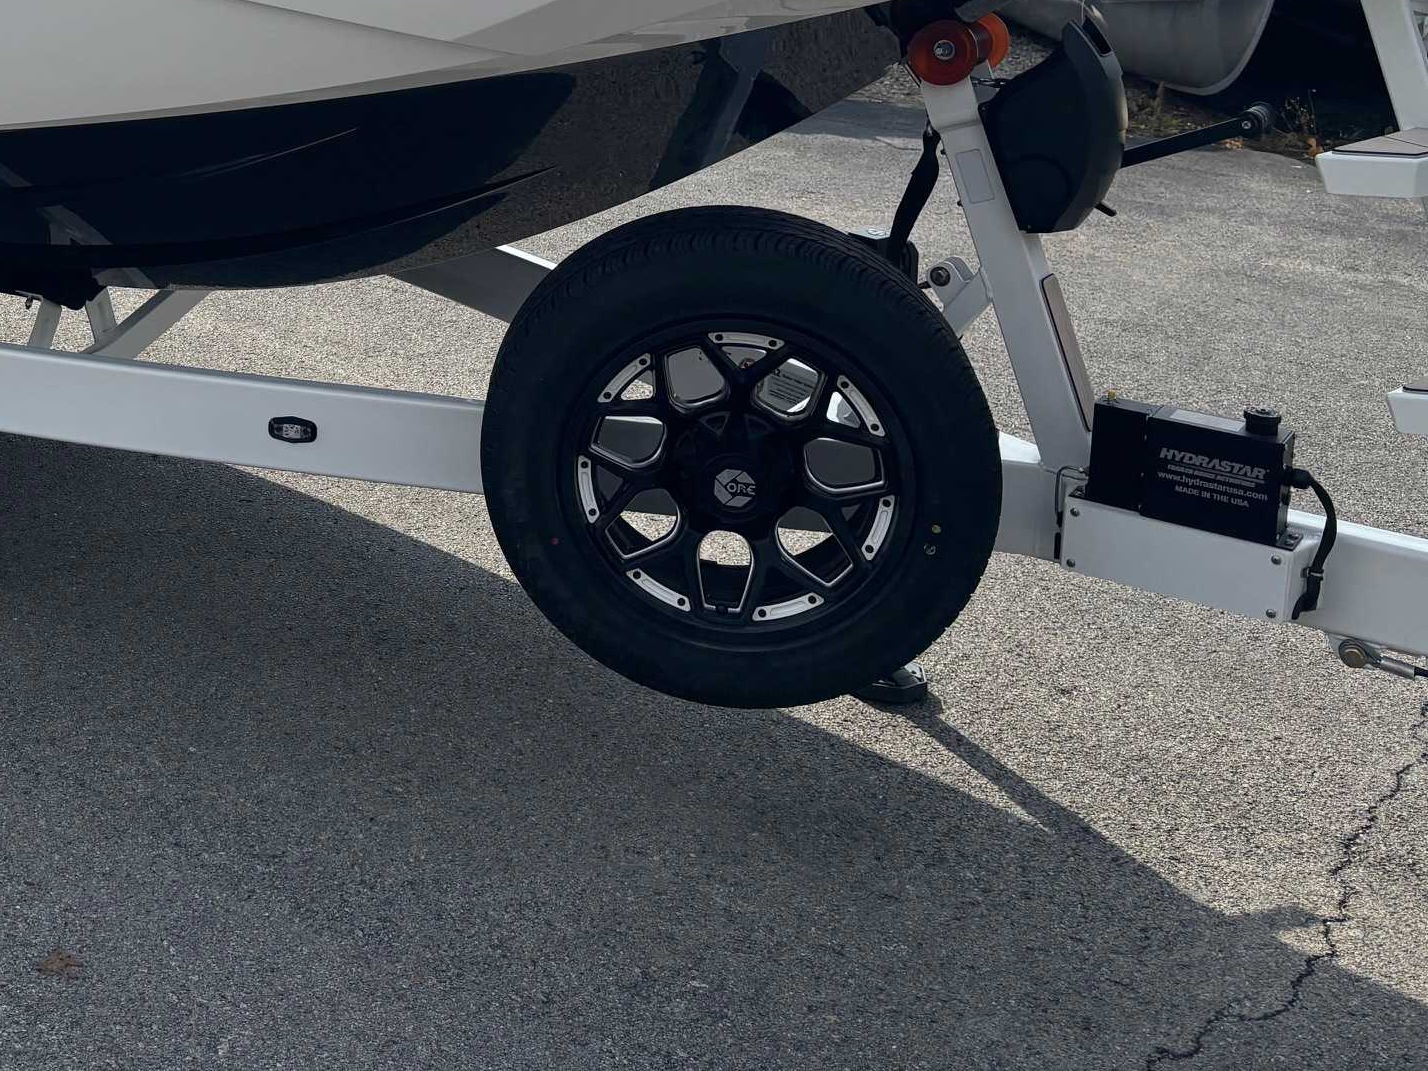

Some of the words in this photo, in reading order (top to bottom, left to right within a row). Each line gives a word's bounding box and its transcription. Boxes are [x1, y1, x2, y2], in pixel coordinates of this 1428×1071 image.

[1159, 447, 1267, 480] HYDRASTAR
[1157, 471, 1268, 501] www.hydrastarusa.com
[1175, 484, 1200, 496] MADE
[1201, 490, 1211, 499] IN
[1213, 493, 1229, 504] THE
[1231, 497, 1250, 508] USA
